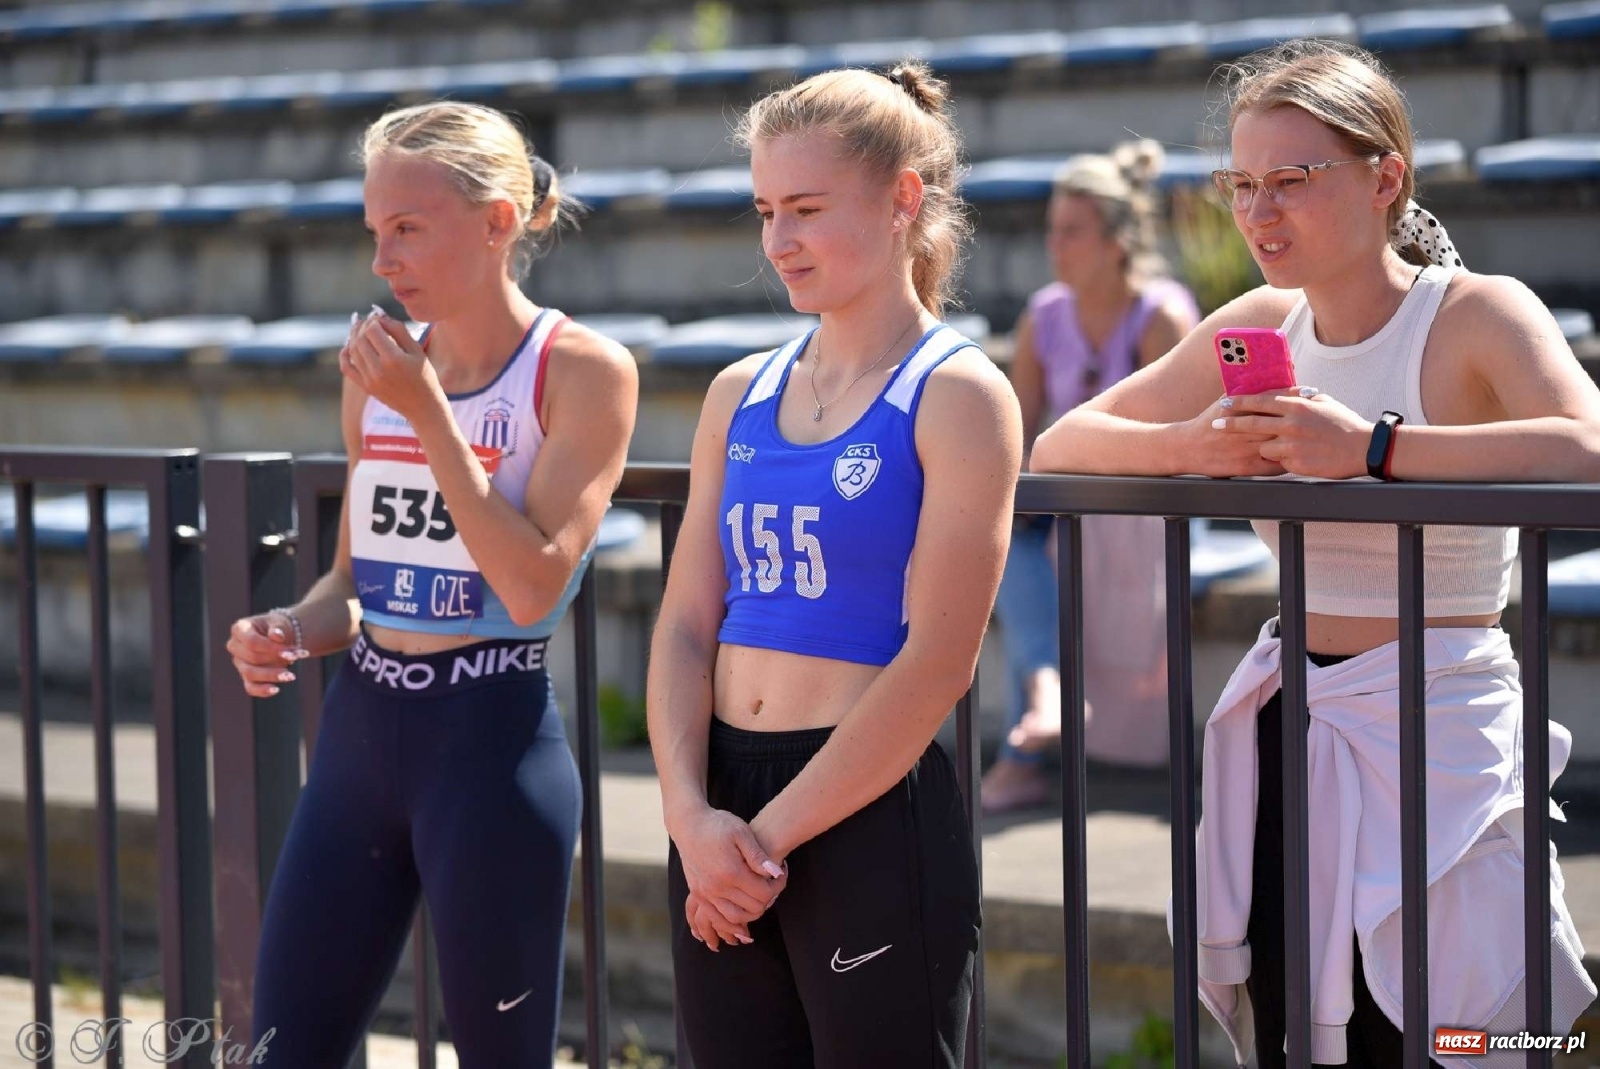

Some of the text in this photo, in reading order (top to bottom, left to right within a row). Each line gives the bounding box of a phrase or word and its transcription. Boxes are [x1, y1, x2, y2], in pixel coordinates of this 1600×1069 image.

[847, 447, 871, 457] CKS
[840, 461, 866, 486] B
[370, 485, 458, 541] 535
[726, 503, 827, 599] 155
[431, 574, 473, 617] CZE
[449, 643, 548, 685] NIKE
